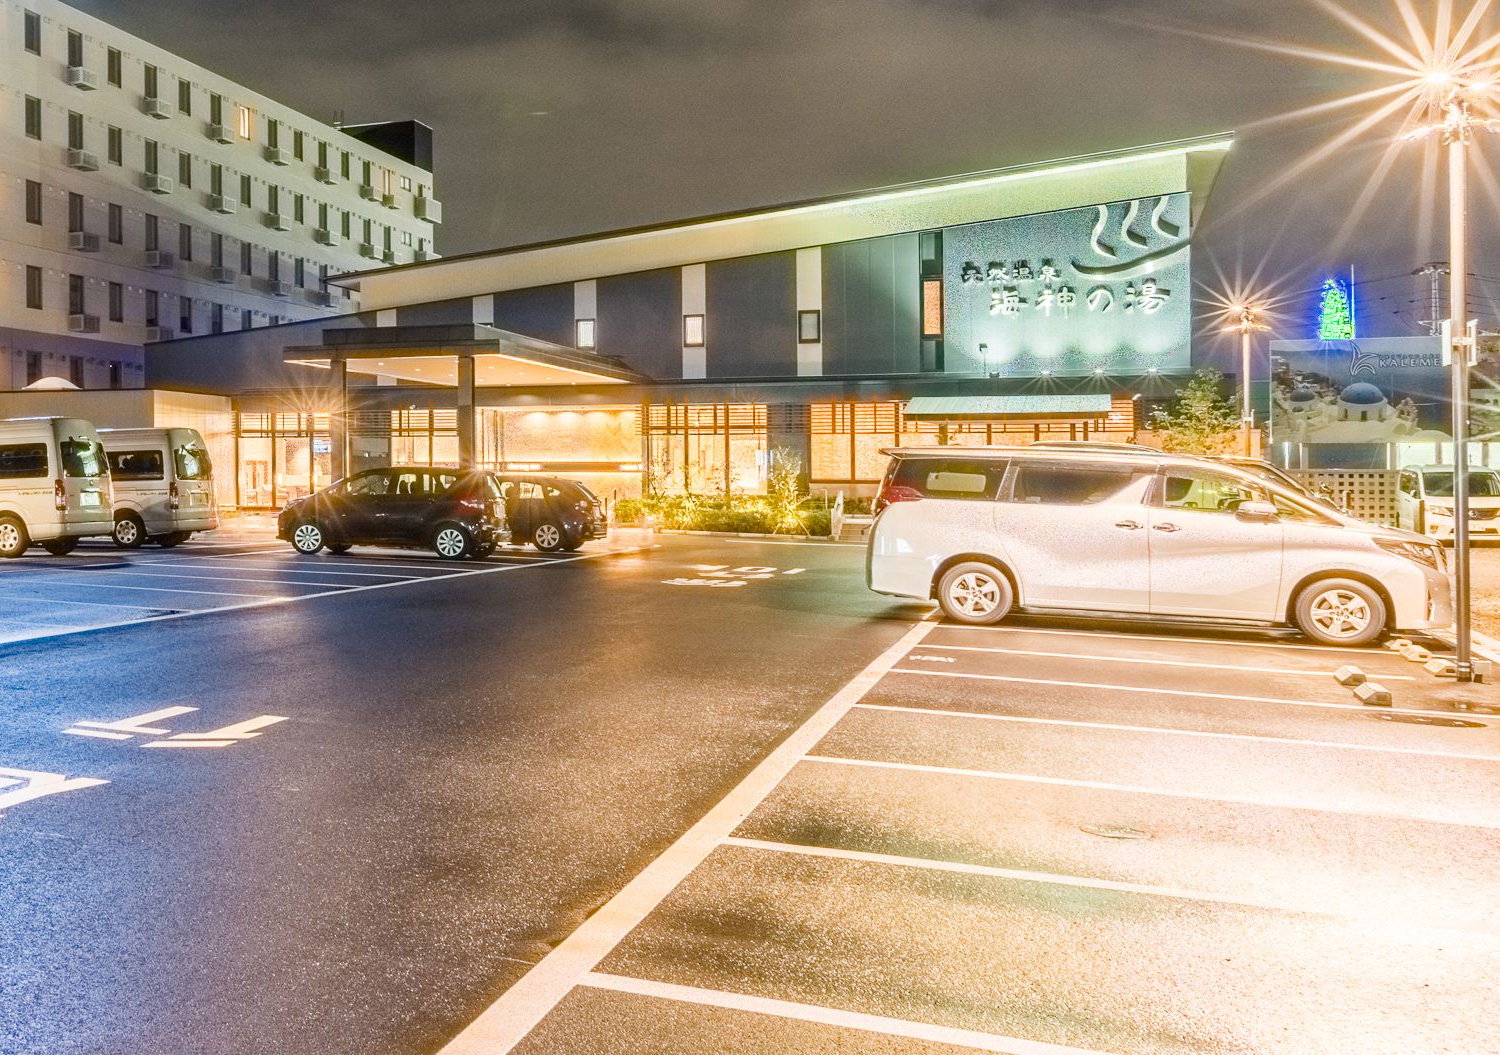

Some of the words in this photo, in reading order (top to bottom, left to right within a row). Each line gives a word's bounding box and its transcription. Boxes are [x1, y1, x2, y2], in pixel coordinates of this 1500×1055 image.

[961, 258, 1062, 286] 天然温泉
[989, 278, 1171, 319] 海神の湯
